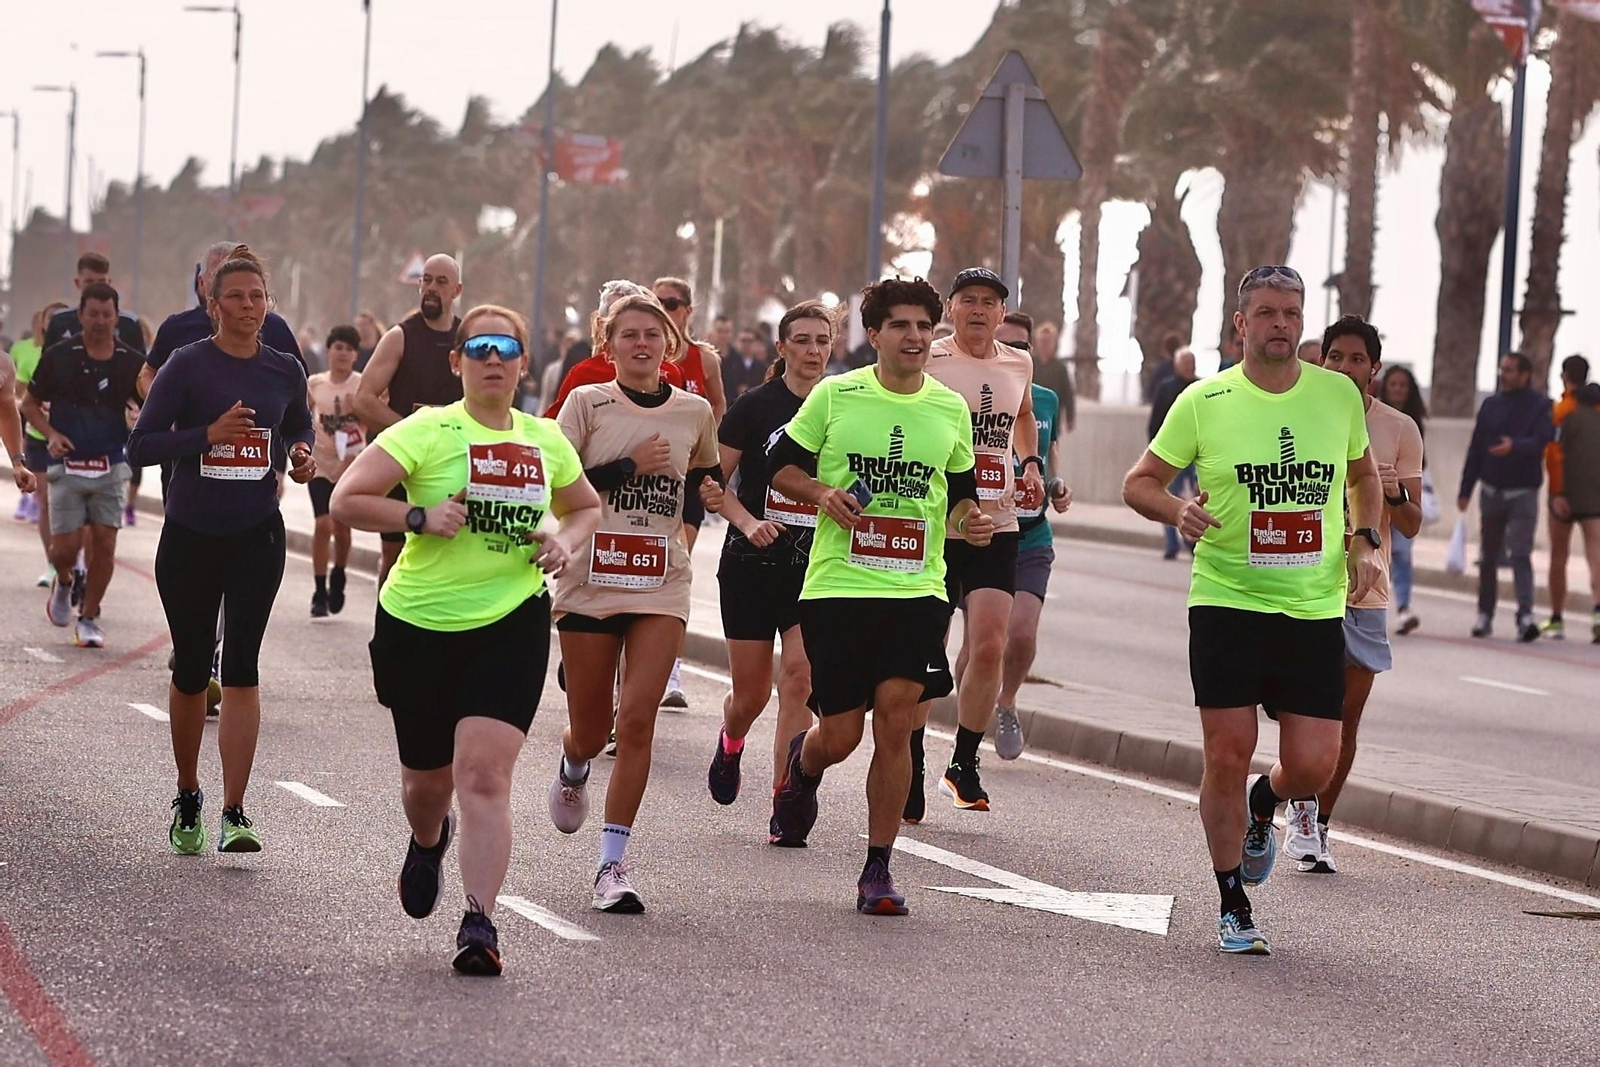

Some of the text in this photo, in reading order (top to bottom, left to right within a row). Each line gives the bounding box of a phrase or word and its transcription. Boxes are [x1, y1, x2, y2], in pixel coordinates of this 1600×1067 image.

[240, 446, 262, 459] 421
[512, 462, 539, 479] 412
[846, 453, 936, 483] BRUNCH
[1234, 460, 1335, 486] BRUNCH
[981, 469, 1001, 482] 533
[608, 485, 649, 513] RUN
[1247, 482, 1297, 510] RUN
[1296, 492, 1329, 506] 2025
[466, 499, 544, 530] RUNCH
[856, 530, 887, 542] BRUNCH
[1253, 528, 1287, 539] BRUNCH
[1297, 530, 1313, 544] 73
[892, 536, 918, 550] 650
[596, 549, 628, 559] BRUNCH
[632, 554, 658, 568] 651
